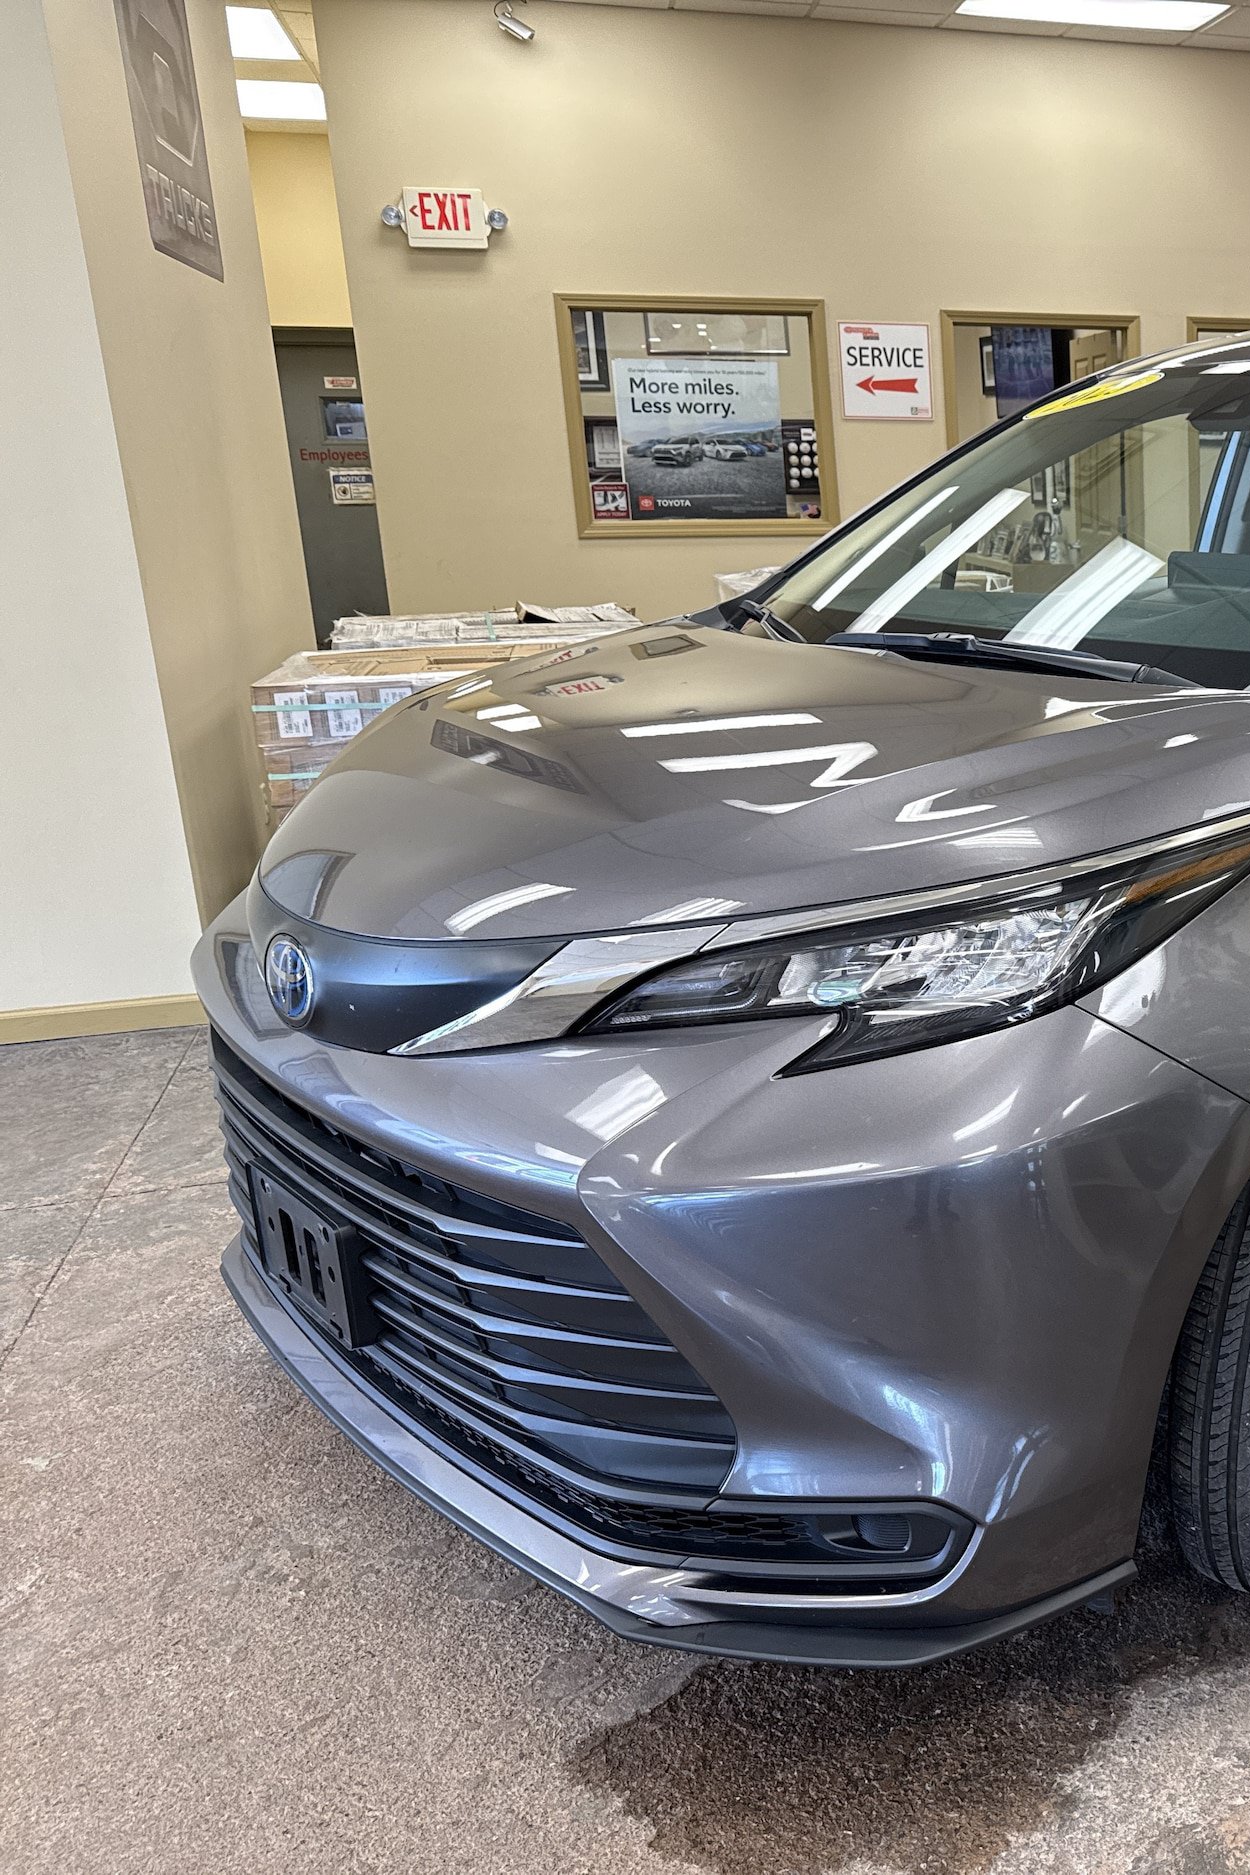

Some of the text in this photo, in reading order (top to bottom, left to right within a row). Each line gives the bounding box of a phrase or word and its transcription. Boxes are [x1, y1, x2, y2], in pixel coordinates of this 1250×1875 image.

[418, 192, 471, 231] EXIT
[846, 346, 924, 368] SERVICE
[629, 377, 739, 396] More miles.
[631, 397, 735, 419] Less worry.
[300, 448, 369, 464] Employees
[339, 475, 366, 483] NOTICE
[656, 499, 691, 507] TOYOTA
